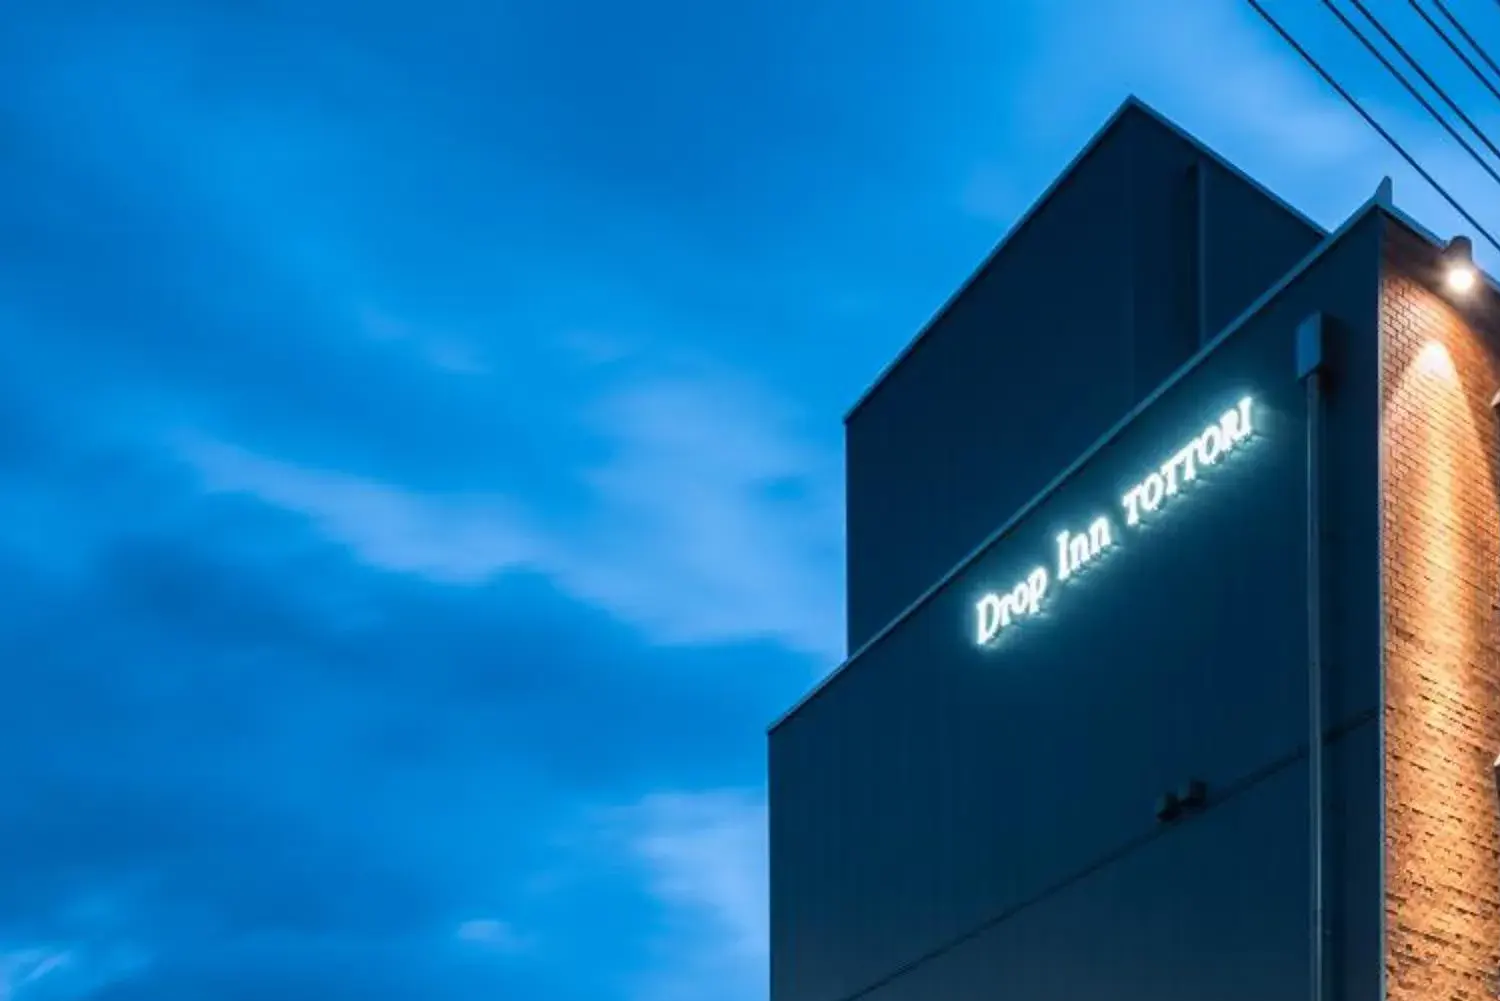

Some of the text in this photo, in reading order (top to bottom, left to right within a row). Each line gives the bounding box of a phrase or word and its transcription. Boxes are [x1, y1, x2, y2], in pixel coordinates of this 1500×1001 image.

[976, 396, 1253, 645] Drop Inn TOTTORI
